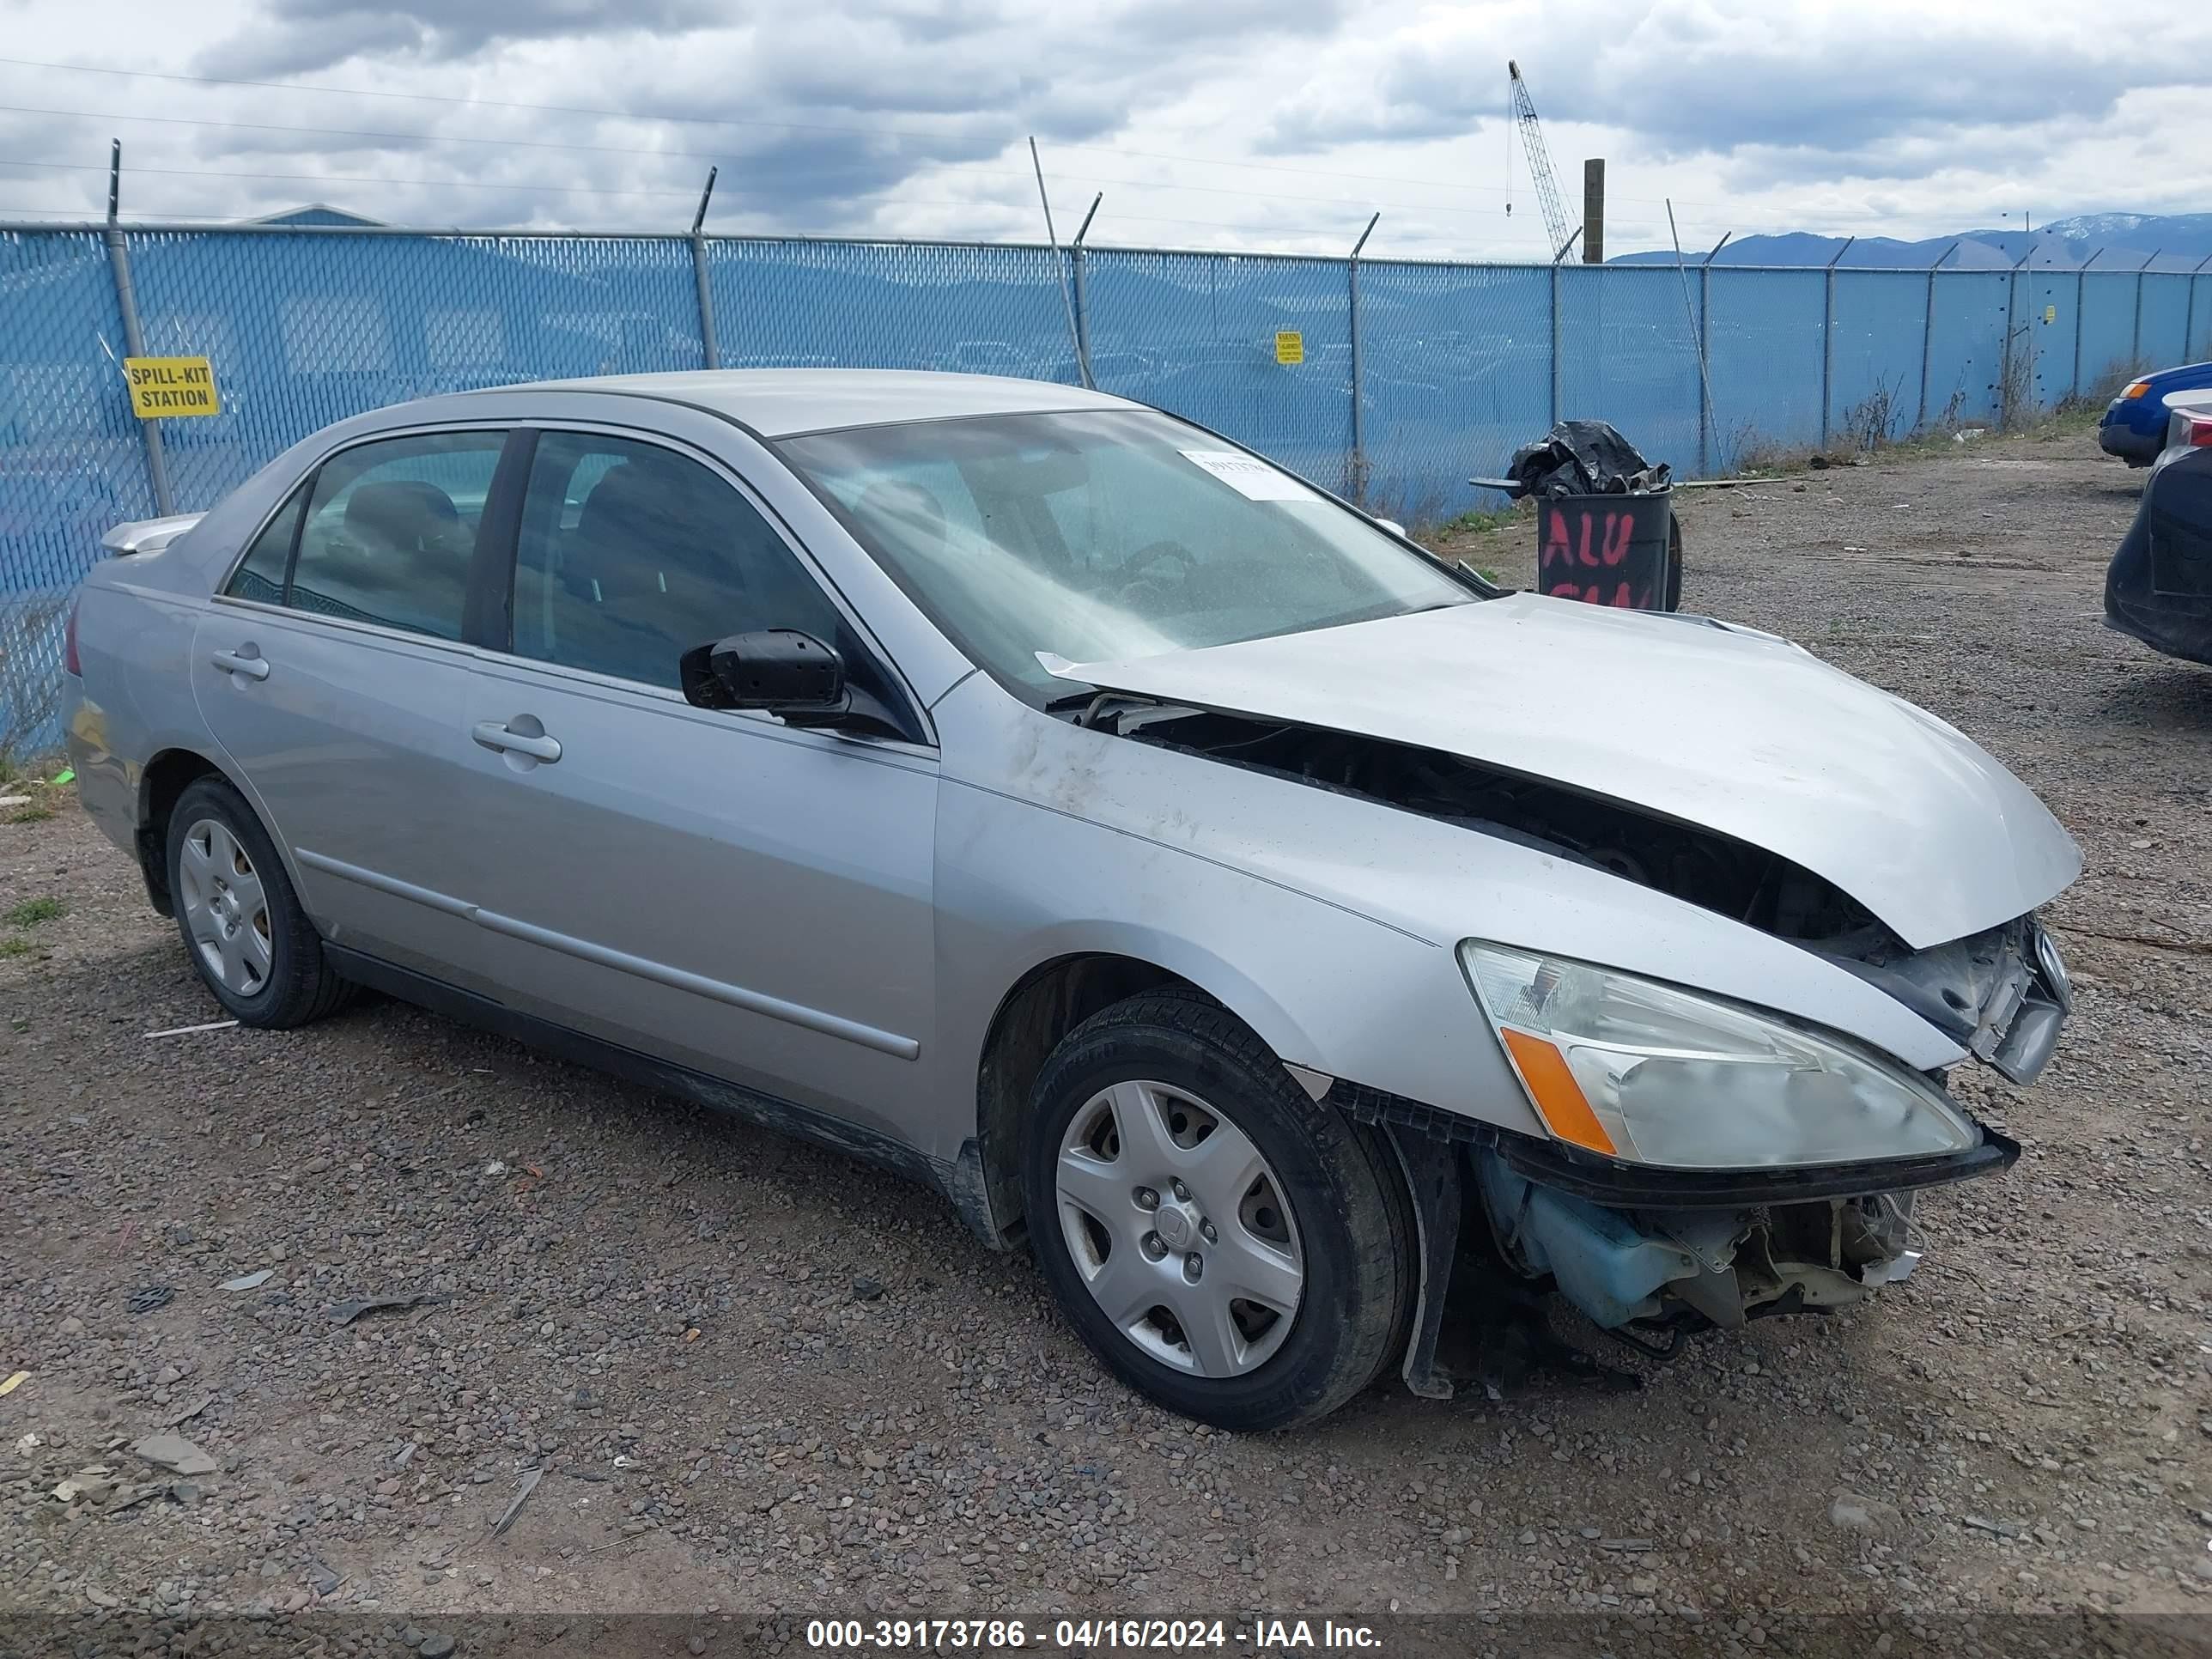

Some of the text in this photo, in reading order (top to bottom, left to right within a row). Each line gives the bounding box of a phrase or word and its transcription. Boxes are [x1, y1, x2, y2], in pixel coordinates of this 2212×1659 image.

[131, 367, 209, 386] SPILL-KIT
[141, 389, 209, 408] STATION
[1542, 508, 1635, 568] ALU
